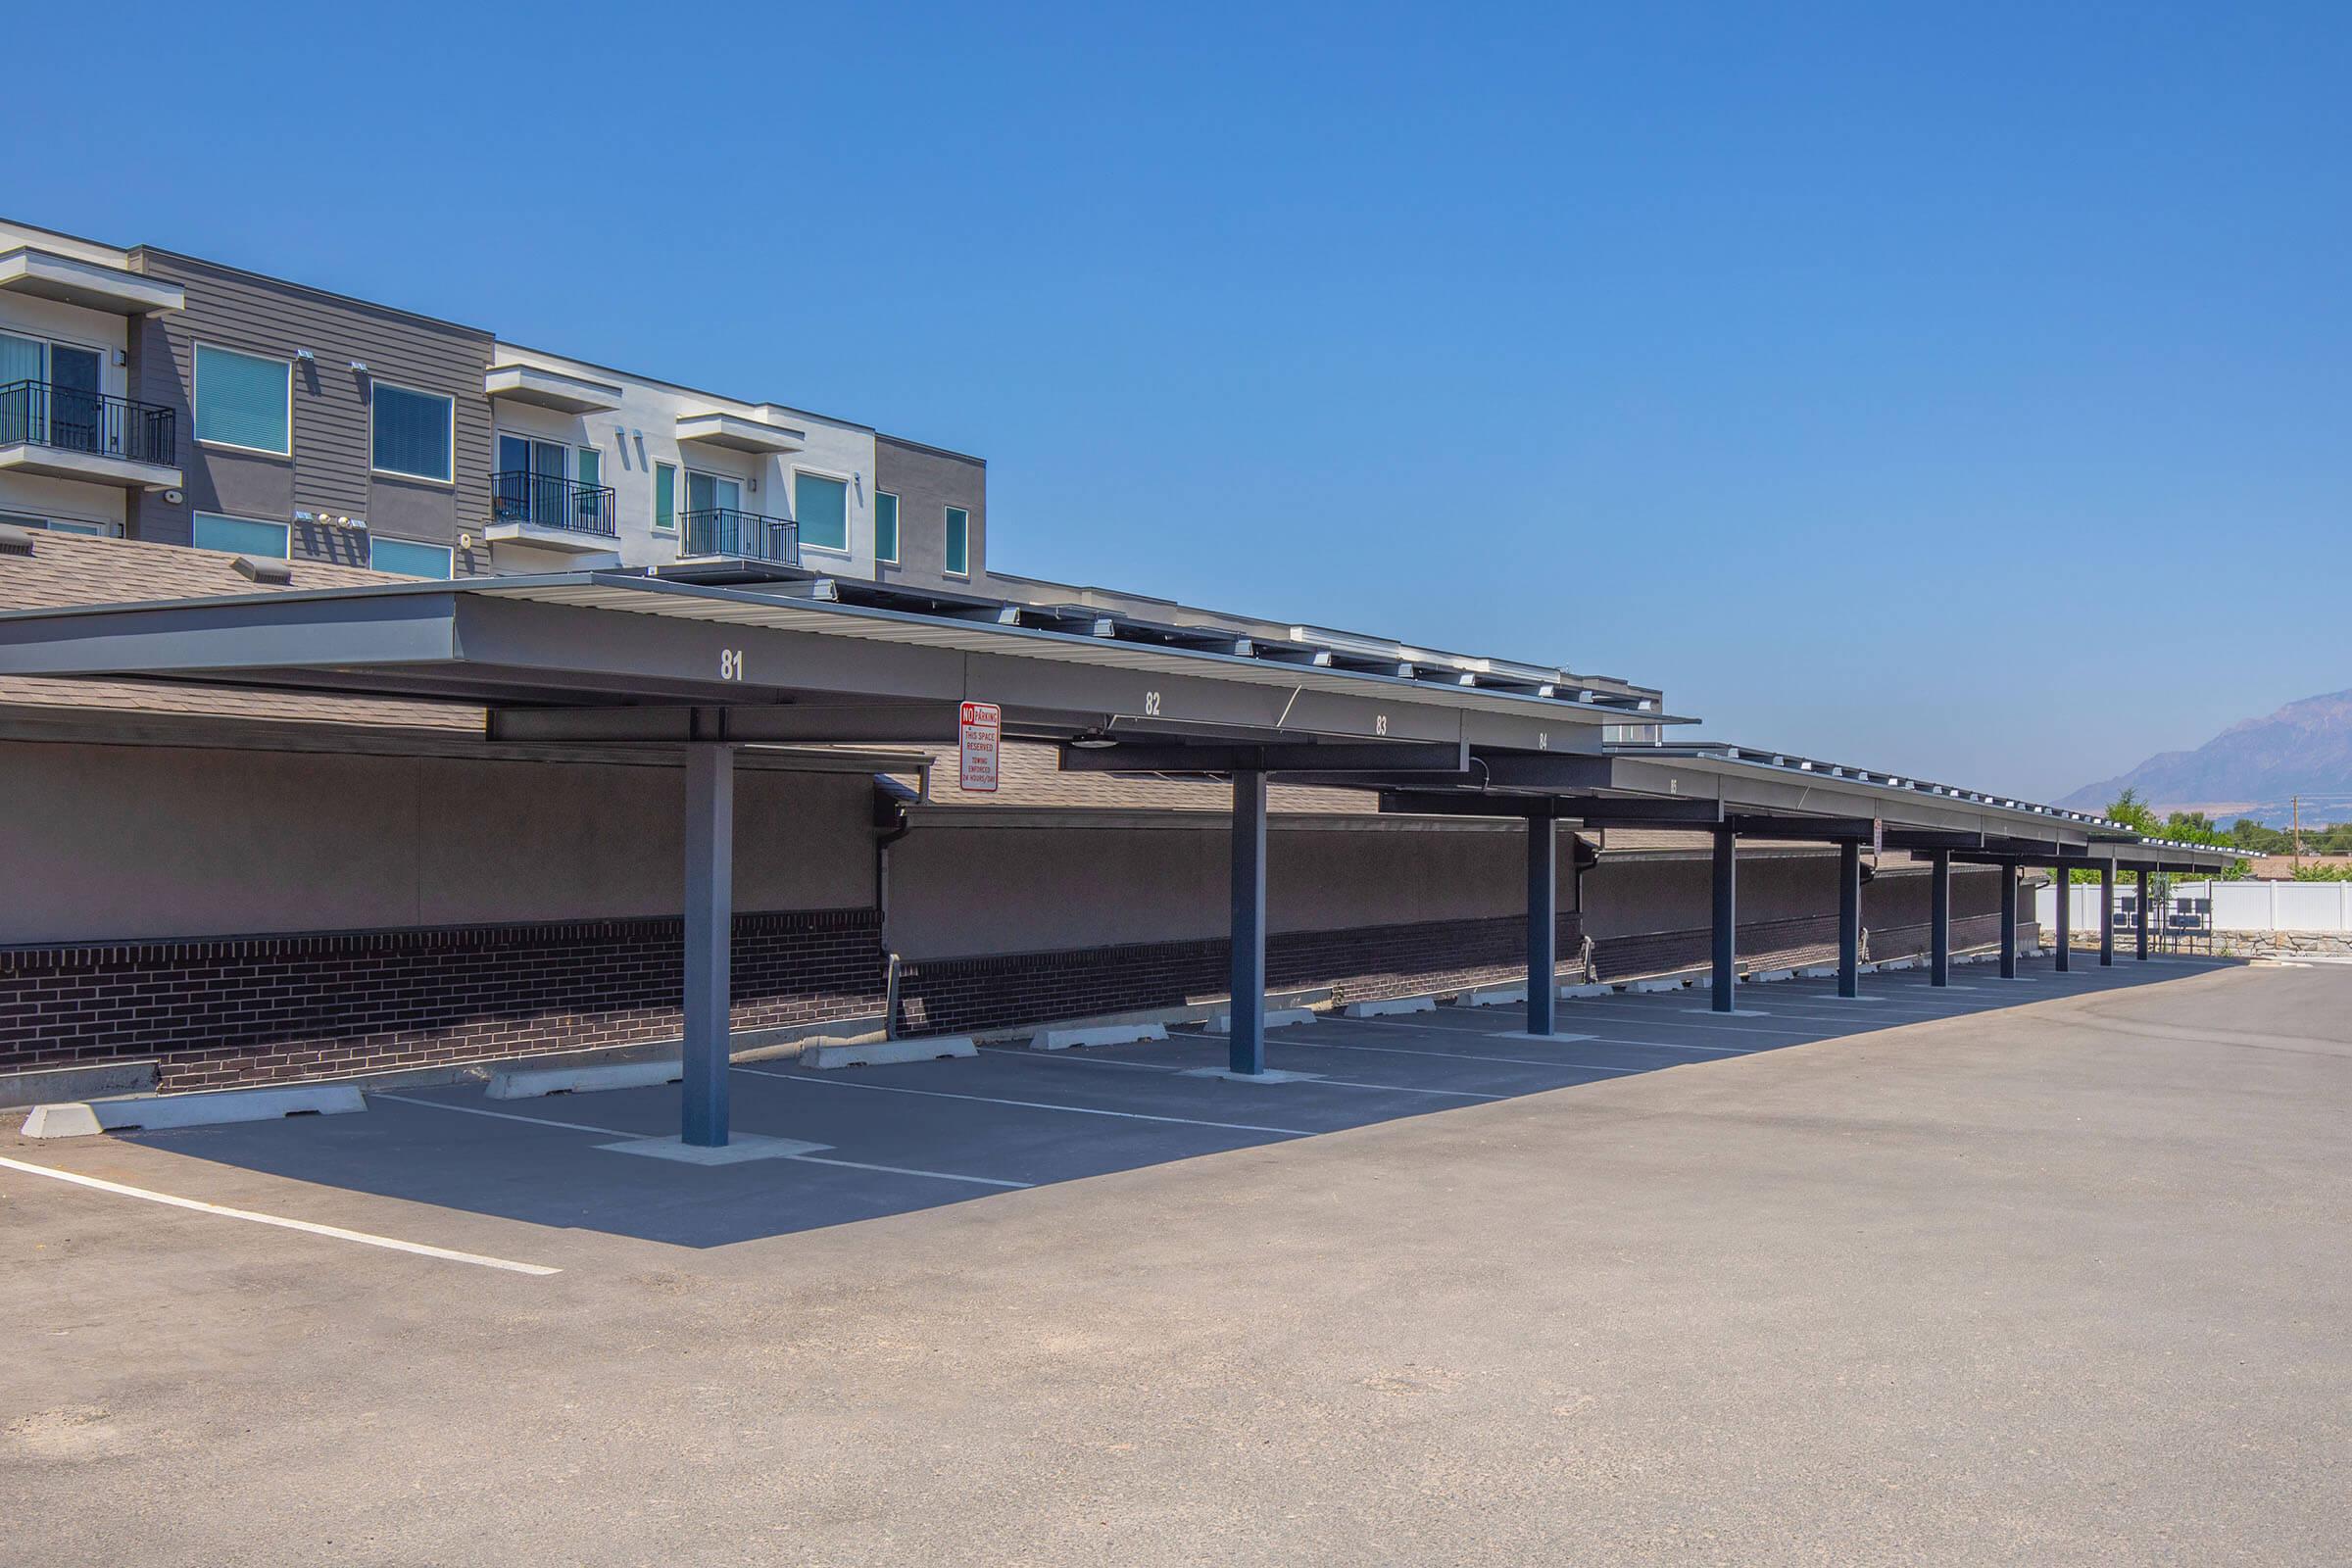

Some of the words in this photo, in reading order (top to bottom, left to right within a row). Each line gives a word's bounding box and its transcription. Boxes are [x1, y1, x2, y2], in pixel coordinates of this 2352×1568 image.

[720, 649, 743, 681] 81
[1145, 692, 1160, 715] 82
[963, 707, 973, 722] NO
[975, 710, 997, 723] PARKING
[1376, 714, 1387, 737] 83
[965, 730, 977, 740] THIS
[978, 732, 995, 741] SPACE
[1539, 733, 1547, 750] 84
[967, 743, 993, 753] RESERVED
